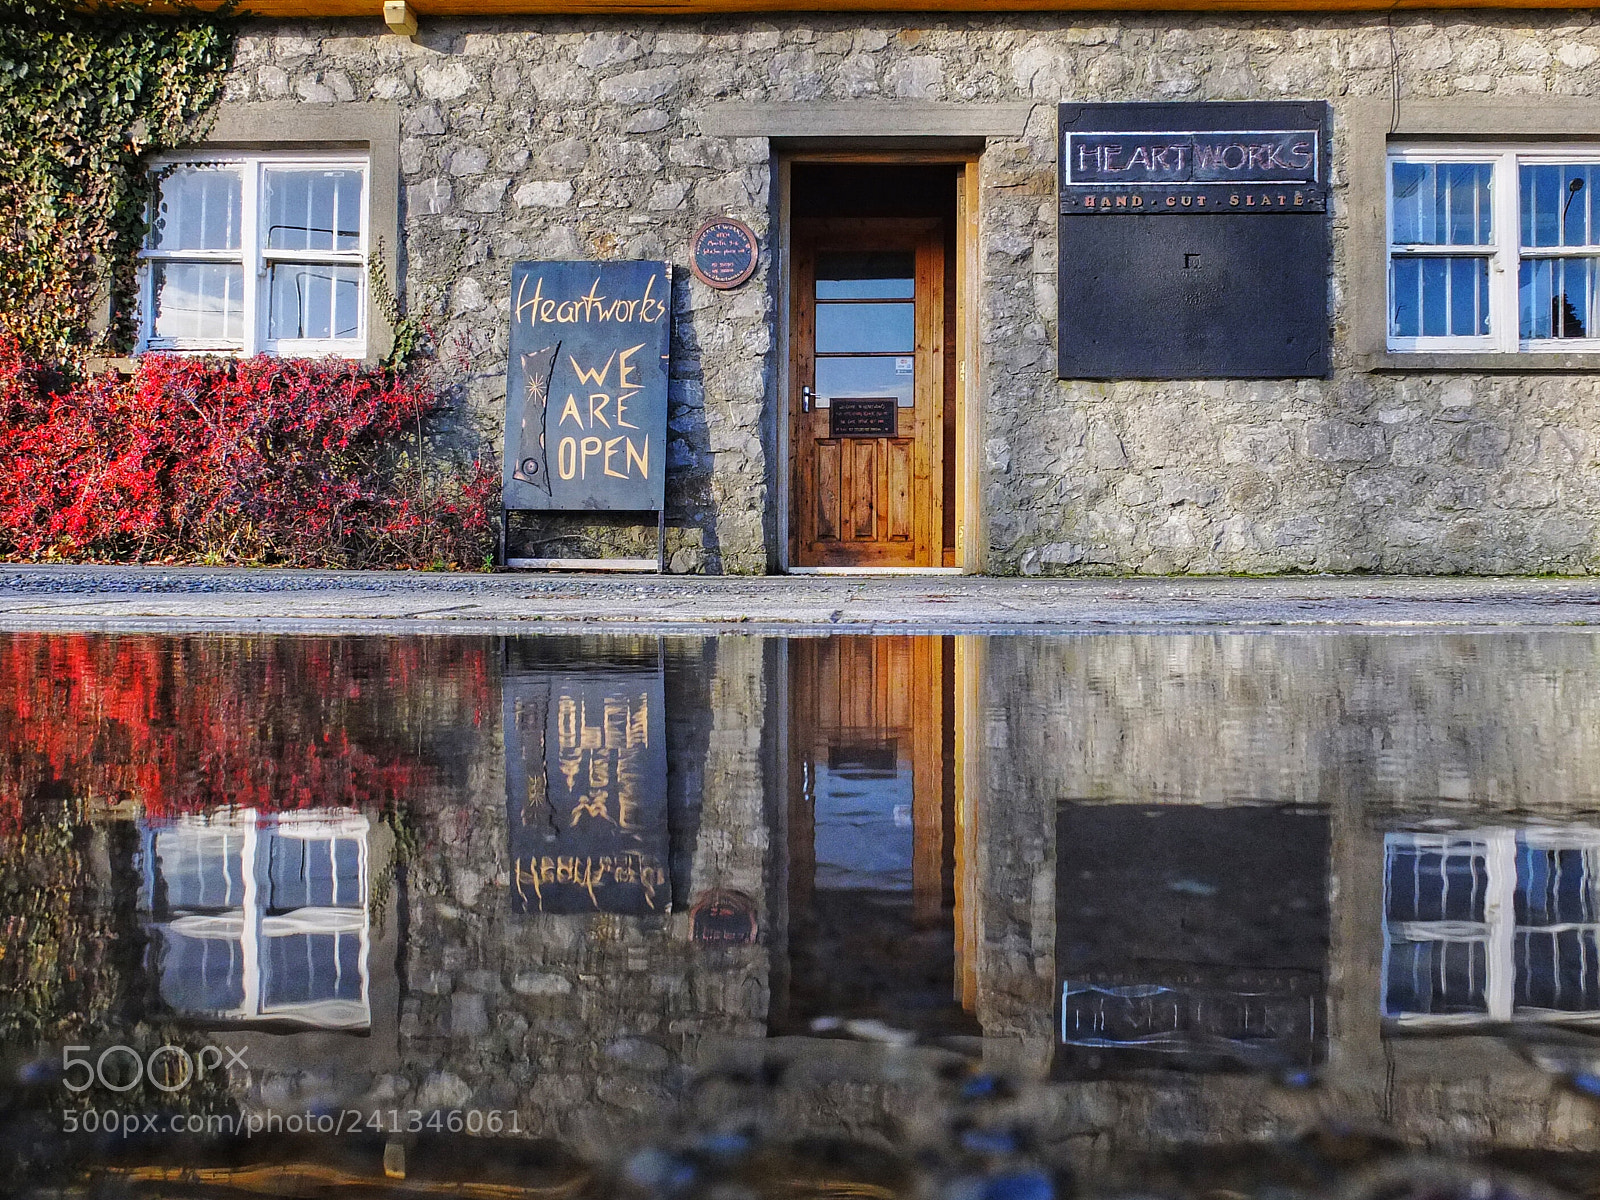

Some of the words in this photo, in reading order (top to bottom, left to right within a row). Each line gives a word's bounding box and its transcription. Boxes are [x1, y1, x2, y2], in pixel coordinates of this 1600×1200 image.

[1077, 142, 1313, 172] HEARTWORKS
[1084, 195, 1143, 207] HAND
[1166, 195, 1207, 206] CUT
[1229, 193, 1304, 206] SLATE
[515, 273, 665, 327] Heartworks
[569, 343, 646, 388] WE
[559, 390, 640, 431] ARE
[558, 433, 648, 480] OPEN
